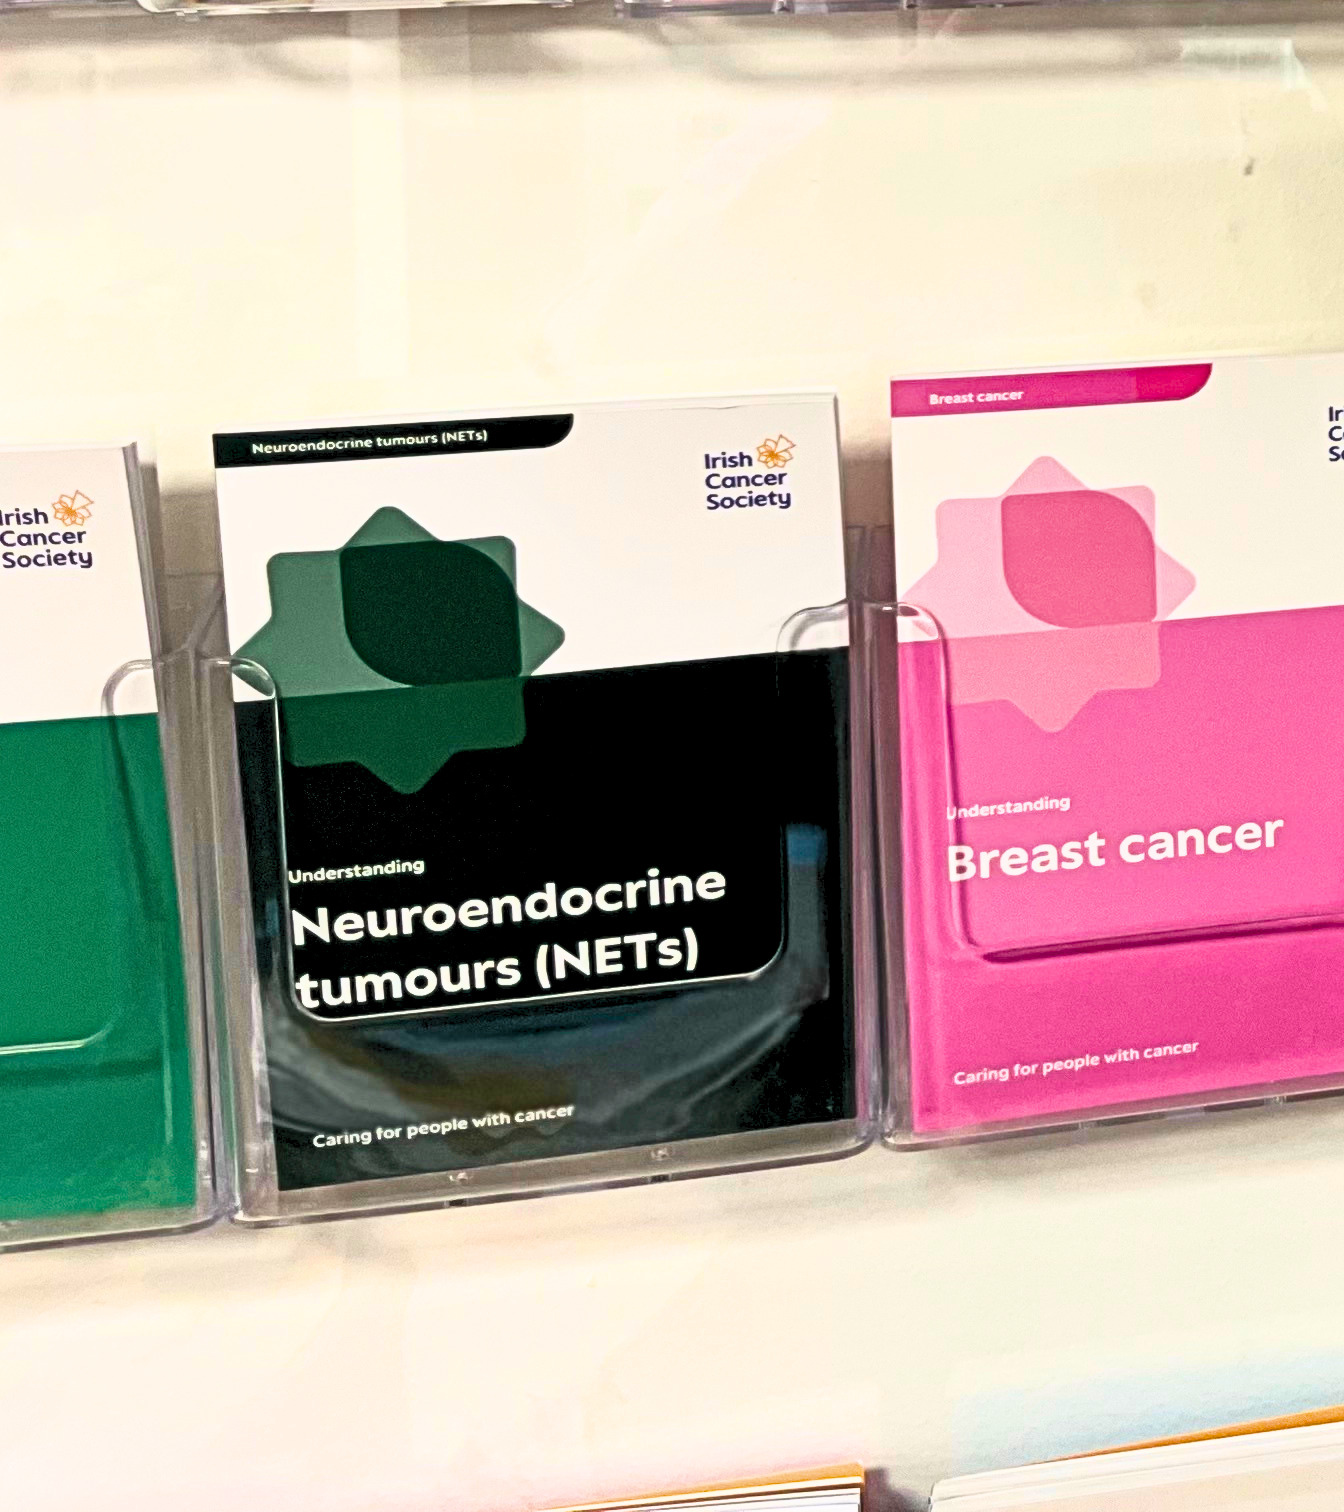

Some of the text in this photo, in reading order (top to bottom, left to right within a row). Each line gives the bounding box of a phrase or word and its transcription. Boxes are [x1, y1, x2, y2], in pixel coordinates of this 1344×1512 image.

[929, 389, 1024, 406] Breast cancer
[252, 429, 489, 455] Neuroendocrine tumours (NETs)
[0, 528, 86, 547] Cancer
[1, 548, 93, 569] Society
[946, 794, 1071, 820] Understanding
[946, 816, 1285, 883] Breast cancer
[288, 857, 425, 884] Understanding
[290, 865, 727, 947] Neuroendocrine
[294, 928, 700, 1008] tumours (NETs)
[954, 1040, 1199, 1085] Caring for people with cancer
[313, 1104, 575, 1149] Caring for people with cancer
